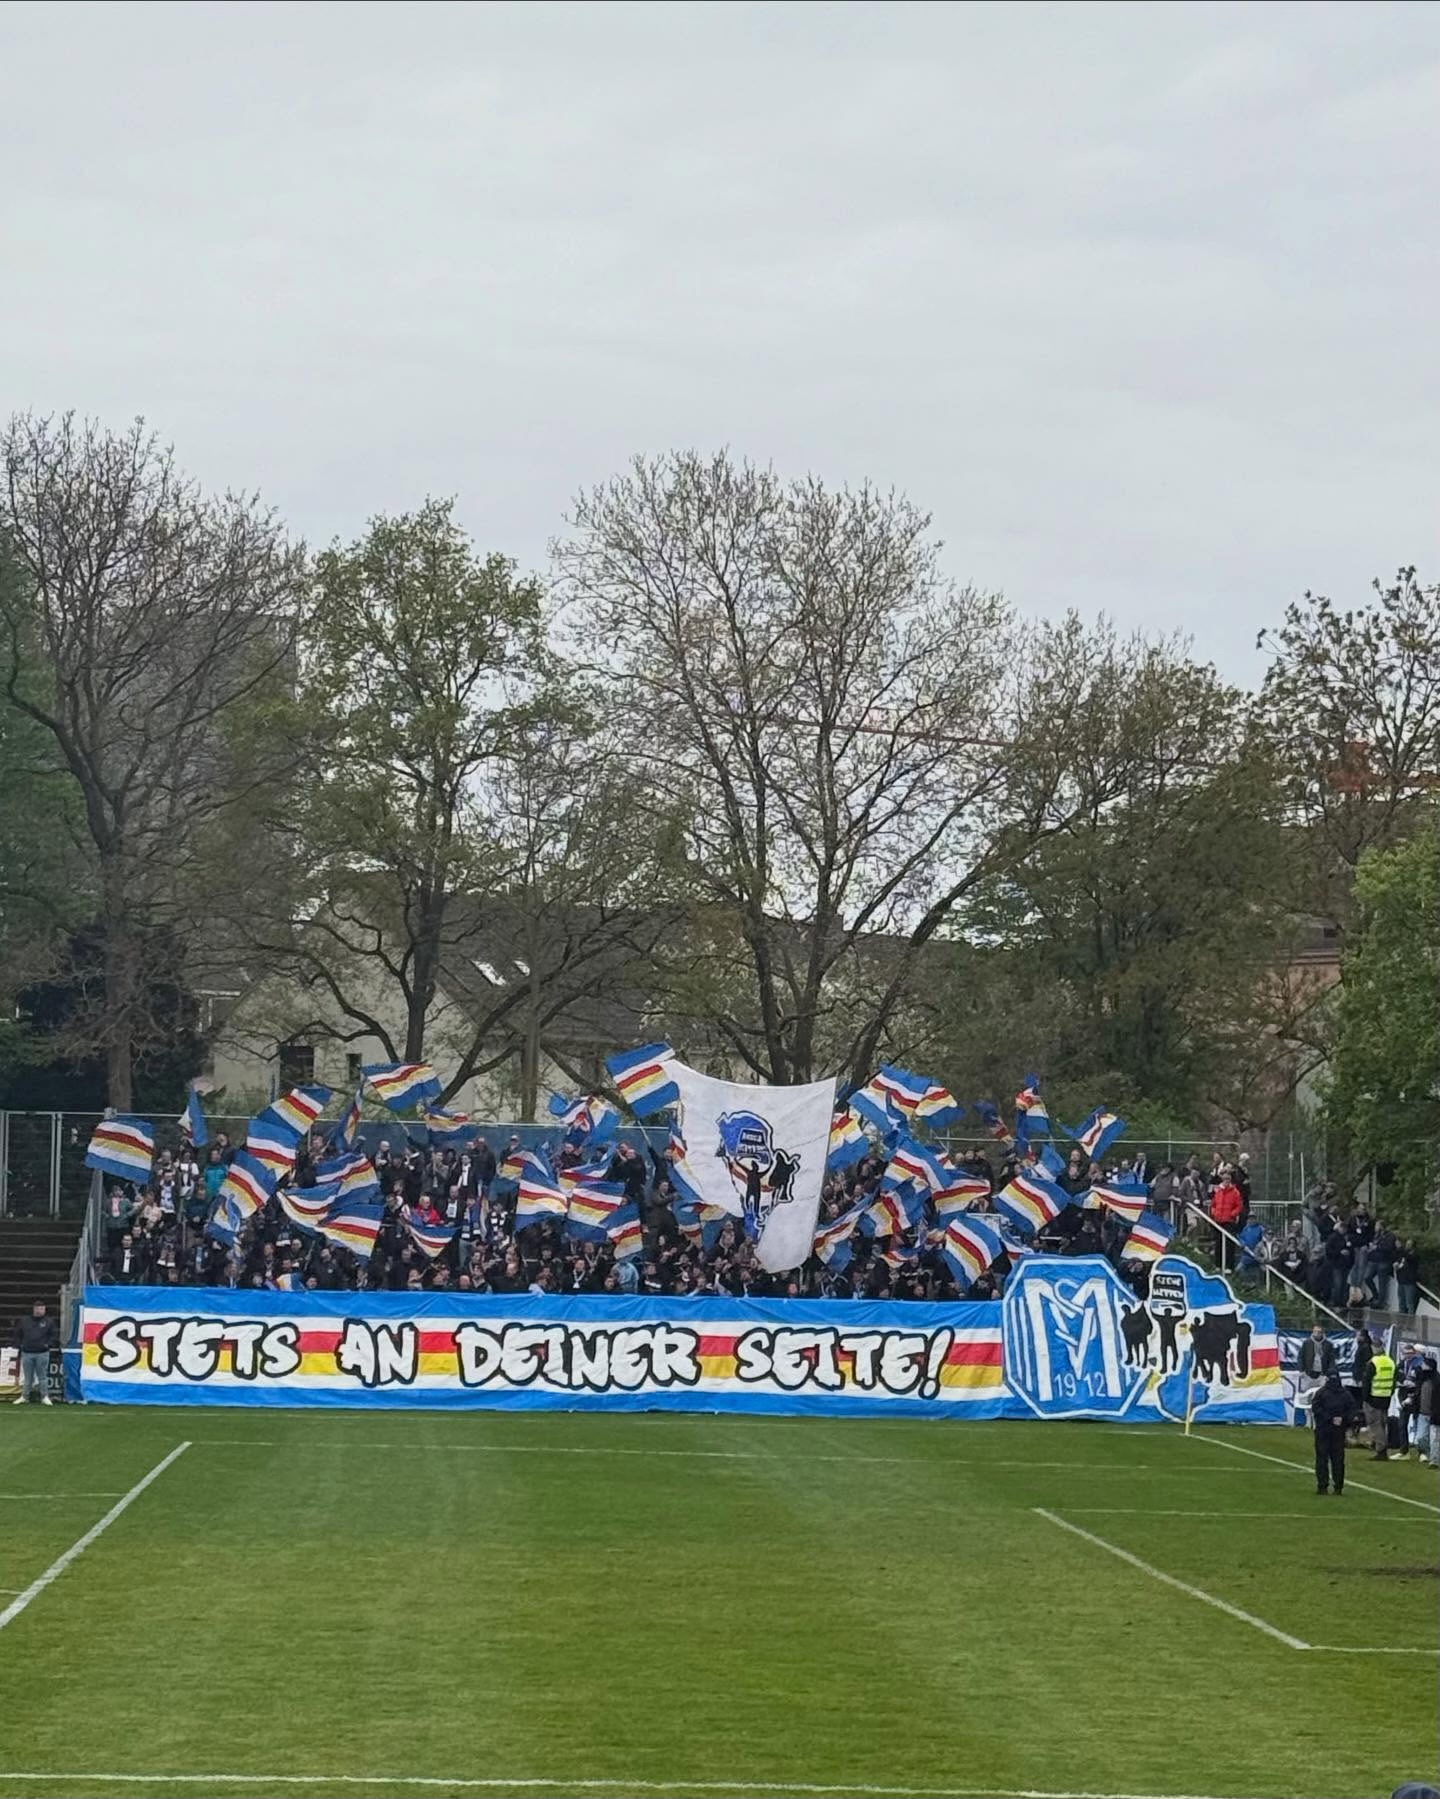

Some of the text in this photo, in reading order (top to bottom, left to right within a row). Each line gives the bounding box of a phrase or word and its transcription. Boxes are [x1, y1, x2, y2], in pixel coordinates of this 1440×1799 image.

[97, 1316, 302, 1381] STETS
[335, 1318, 419, 1388] AN
[453, 1322, 702, 1393] DEINER
[733, 1325, 955, 1400] SEITE!
